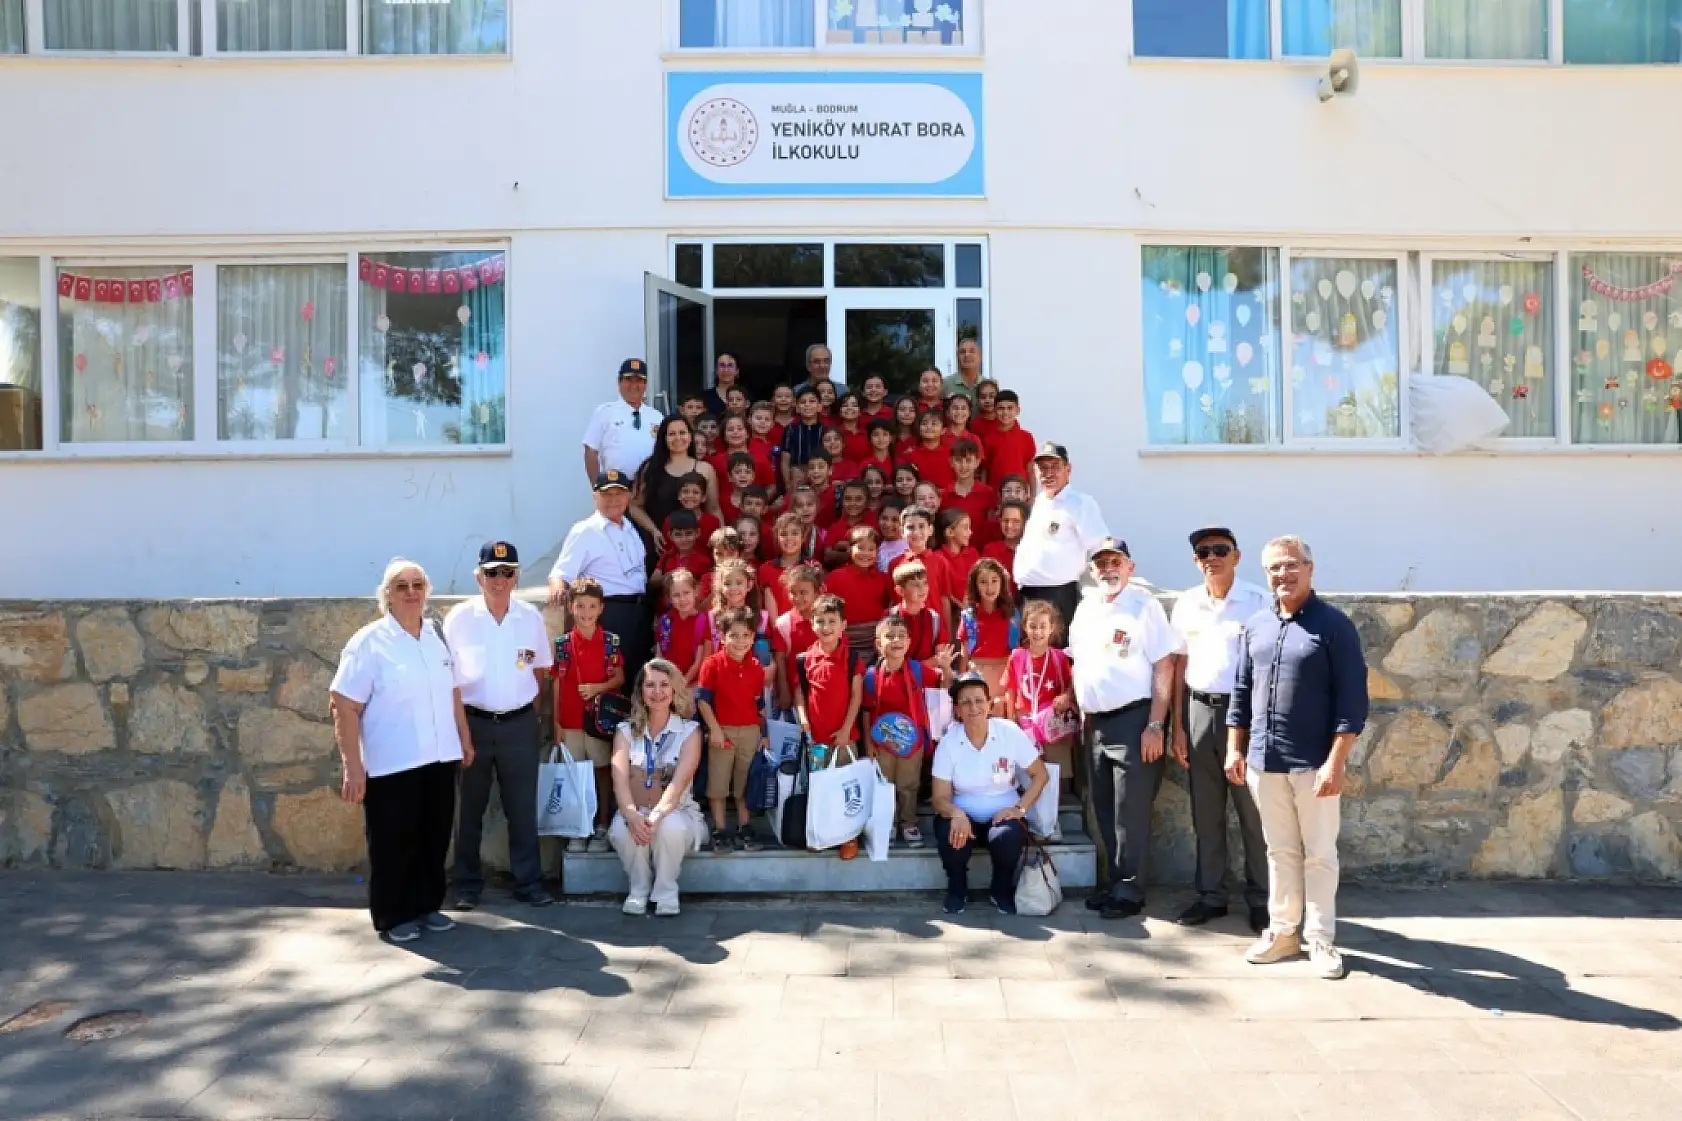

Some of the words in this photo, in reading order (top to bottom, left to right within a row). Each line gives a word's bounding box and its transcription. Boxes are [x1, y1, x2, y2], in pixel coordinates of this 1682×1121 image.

[771, 103, 806, 113] MUĞLA
[816, 104, 858, 113] BODRUM
[771, 119, 845, 137] YENİKÖY
[851, 122, 912, 137] MURAT
[916, 122, 966, 137] BORA
[772, 141, 859, 160] İLKOKULU
